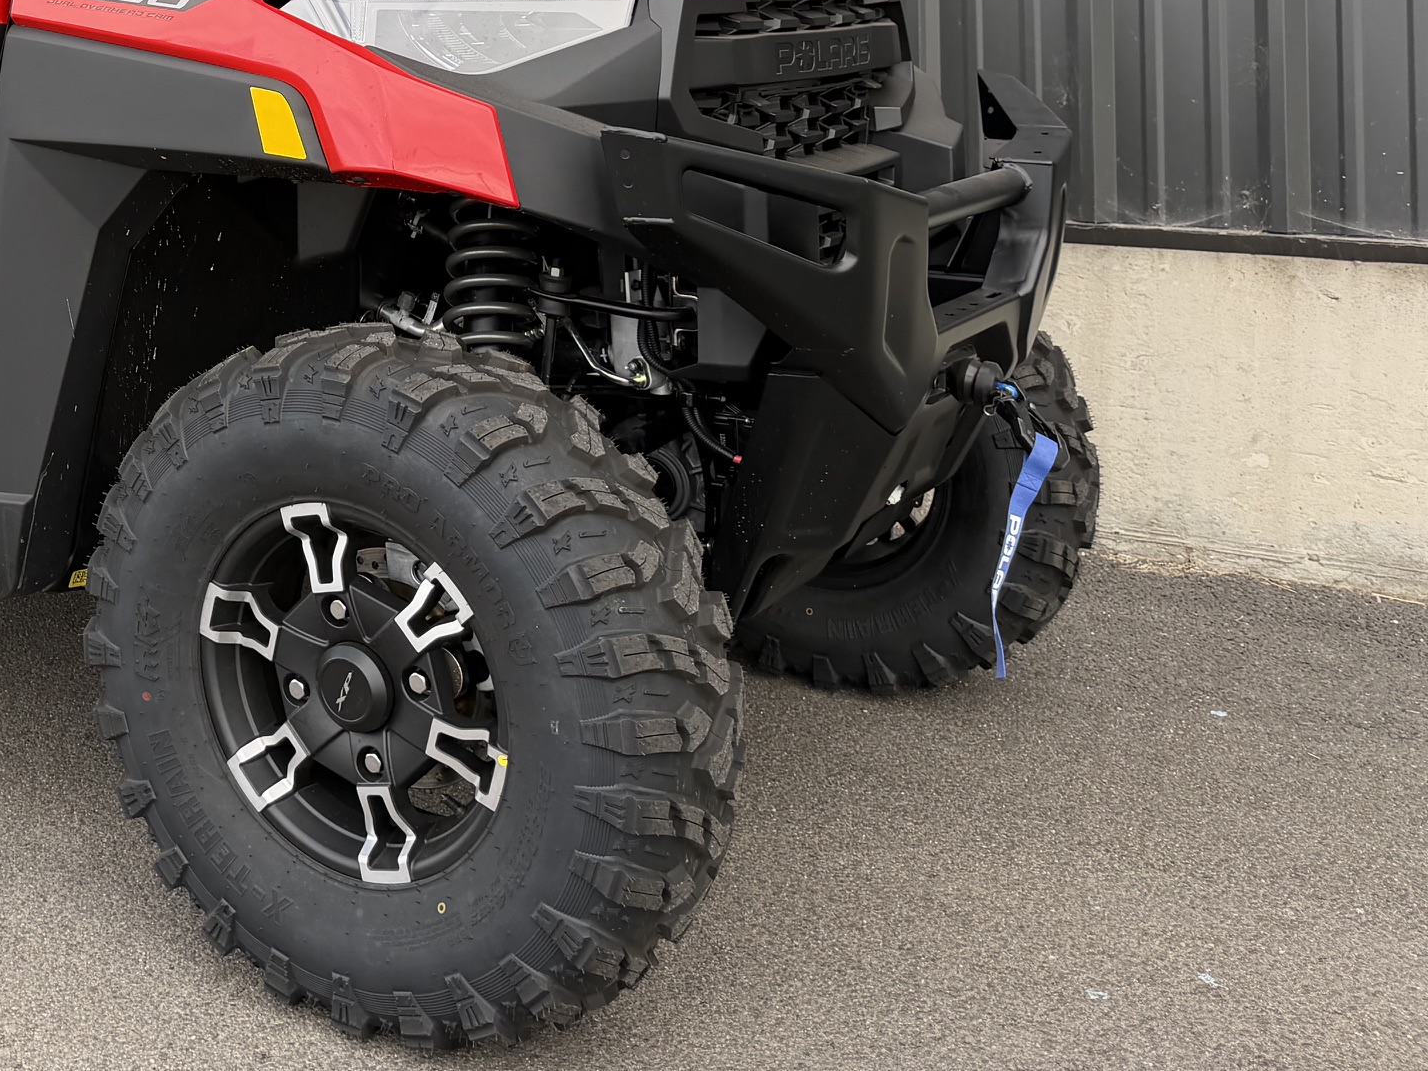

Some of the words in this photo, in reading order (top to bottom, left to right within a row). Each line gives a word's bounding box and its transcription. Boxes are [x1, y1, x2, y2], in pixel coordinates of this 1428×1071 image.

[79, 3, 144, 18] OVERHEAD
[145, 12, 175, 22] CAM
[775, 34, 871, 76] POLARIS
[361, 461, 422, 514] PRO
[427, 507, 516, 630] ARMOR
[335, 670, 354, 713] XP
[147, 728, 295, 926] X-TERRAIN
